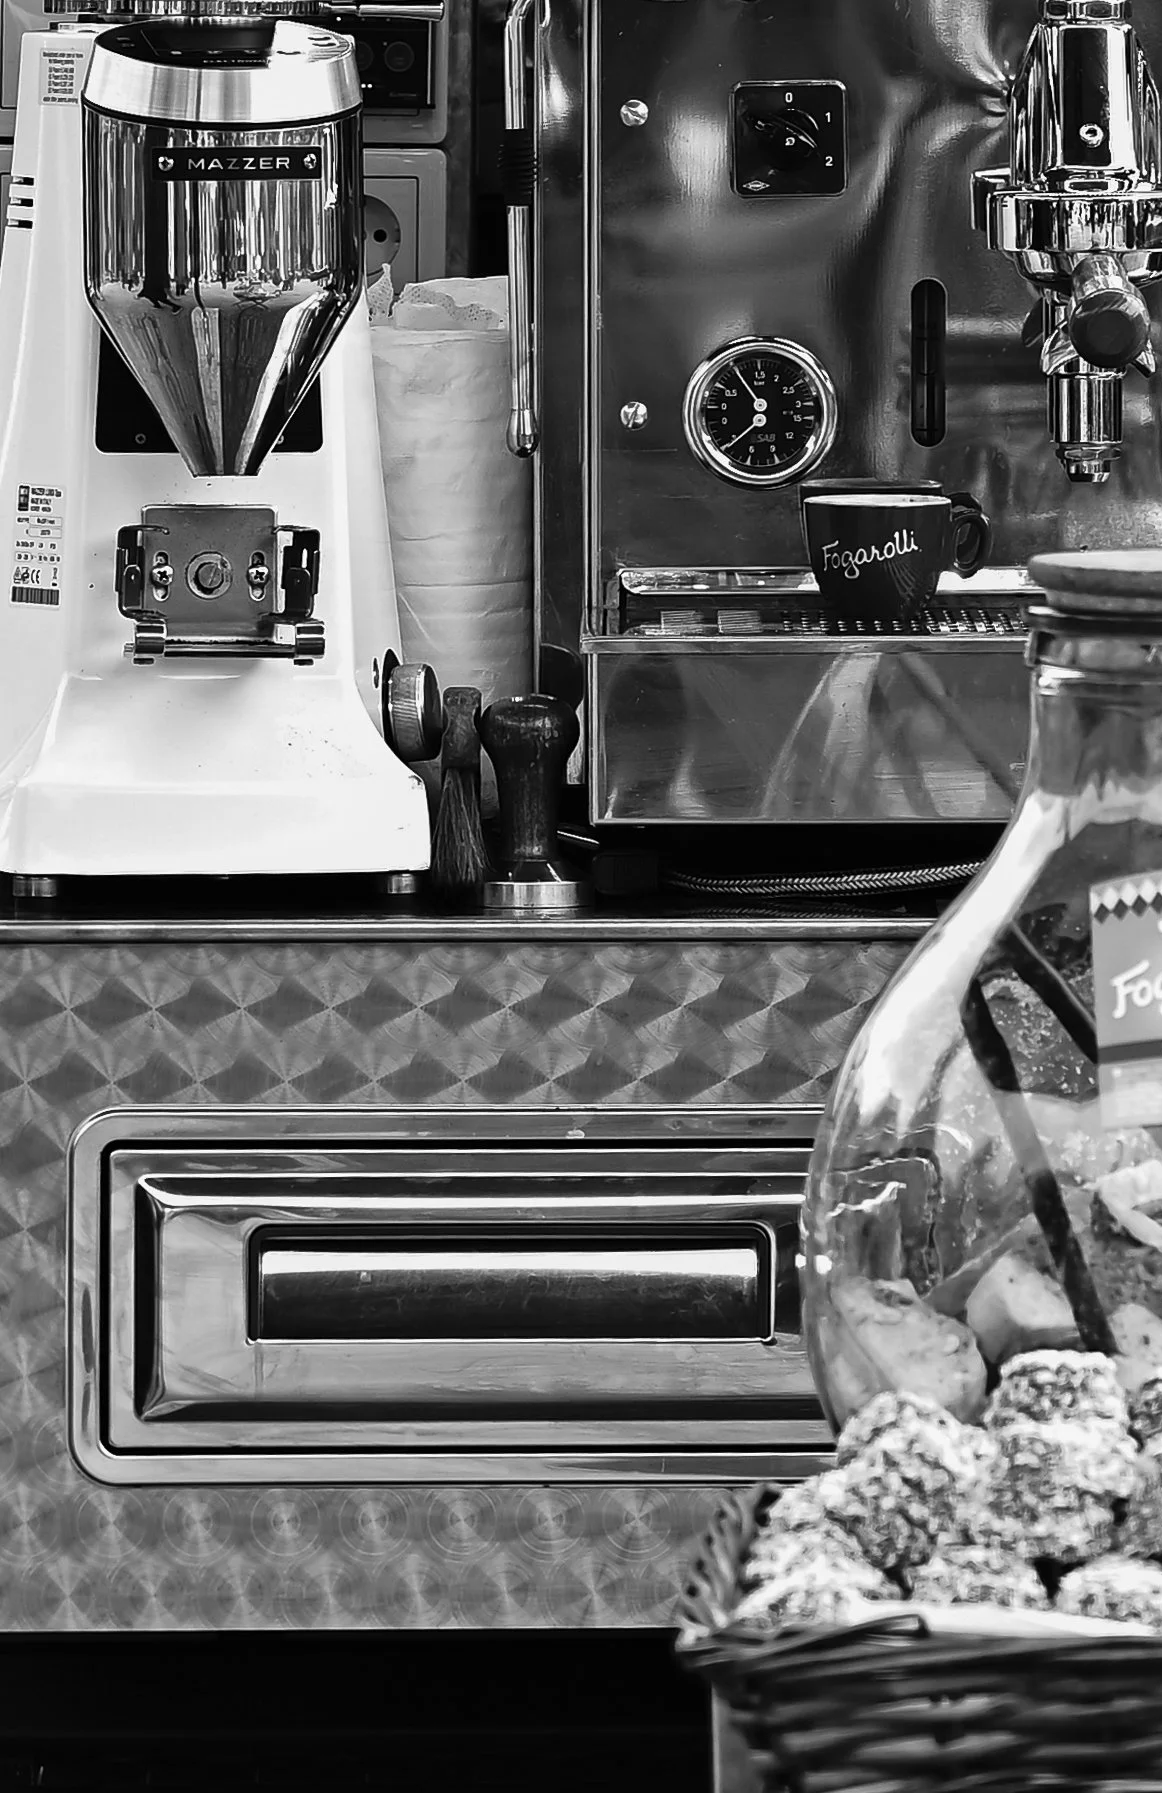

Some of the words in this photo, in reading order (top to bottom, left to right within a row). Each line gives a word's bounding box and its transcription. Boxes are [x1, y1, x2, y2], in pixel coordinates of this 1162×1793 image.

[785, 92, 793, 103] 0
[825, 111, 831, 123] 1
[188, 156, 290, 170] MAZZER
[825, 156, 833, 167] 2
[821, 529, 923, 578] Fogarolli
